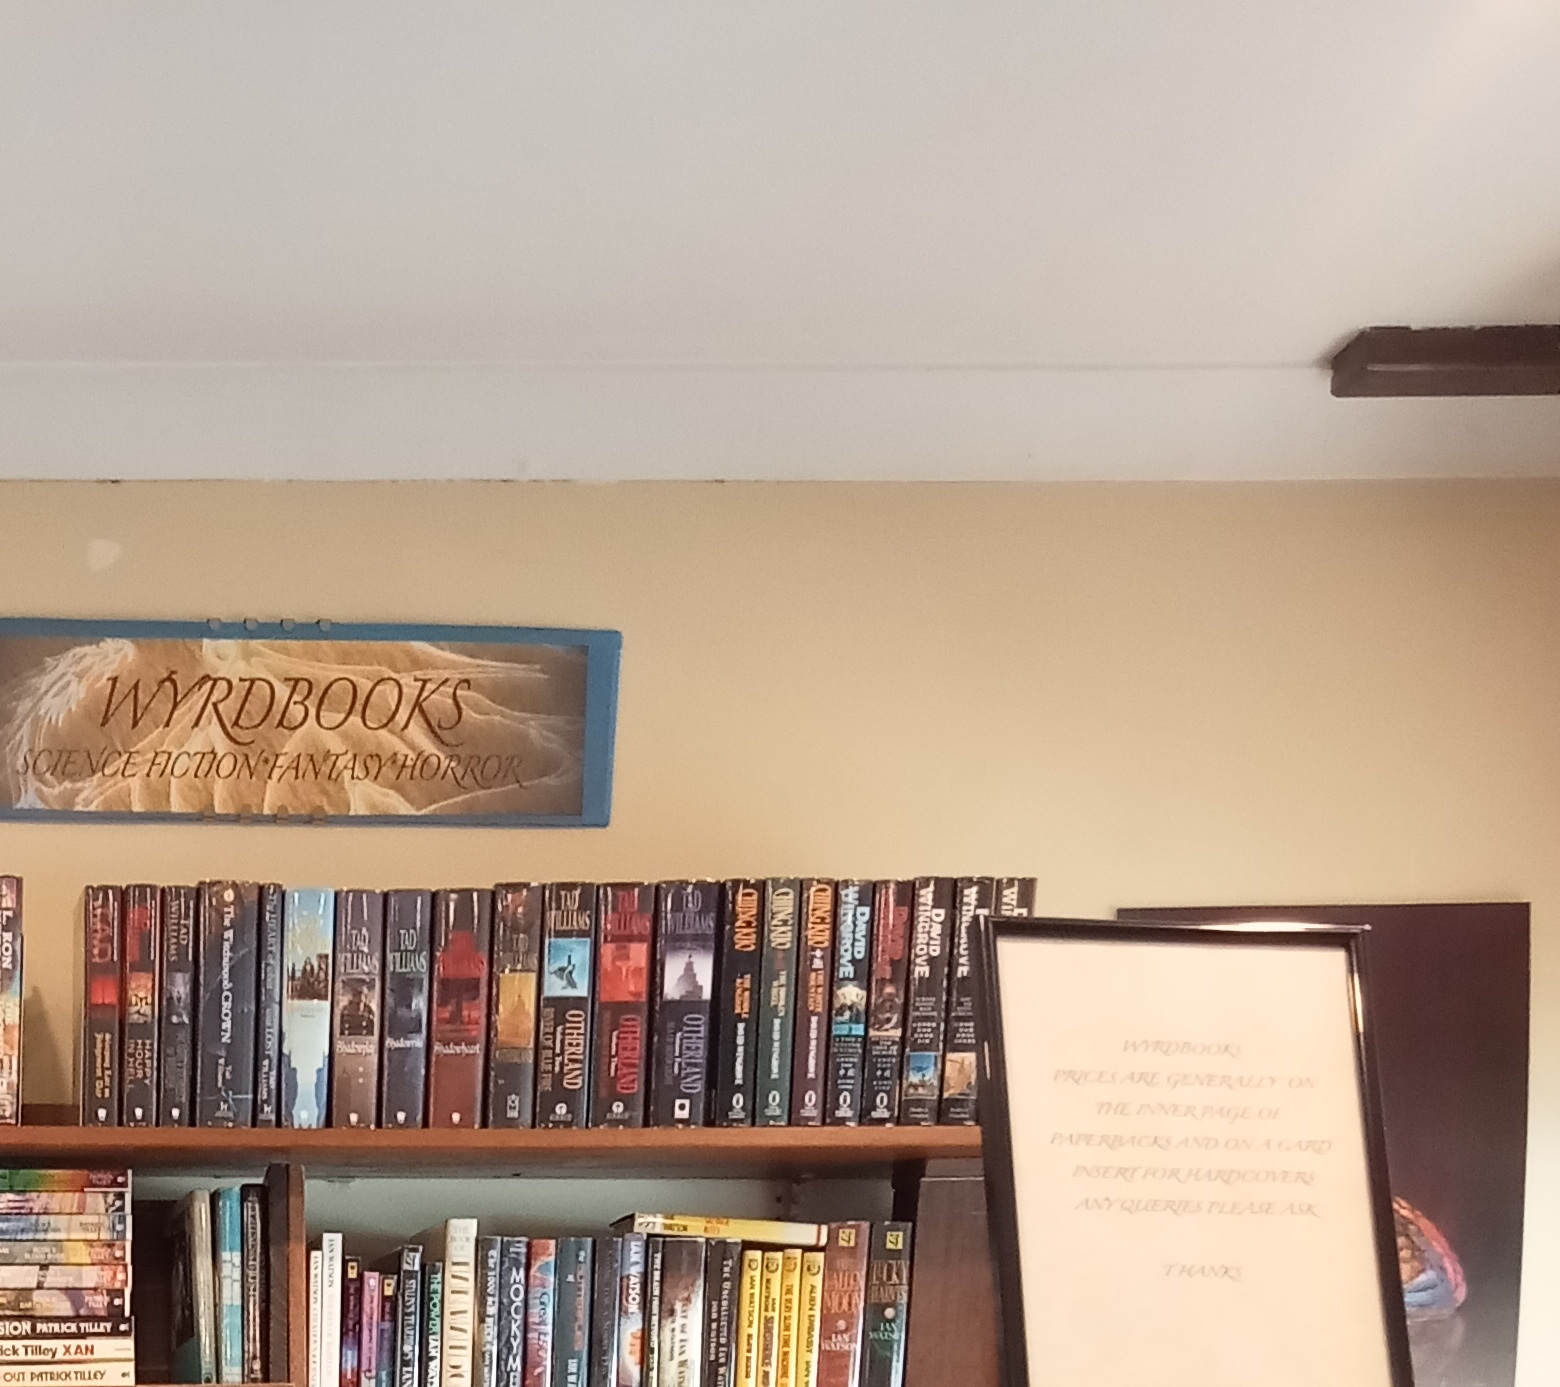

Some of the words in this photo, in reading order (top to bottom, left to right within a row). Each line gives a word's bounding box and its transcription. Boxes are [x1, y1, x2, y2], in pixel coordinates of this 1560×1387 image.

[100, 671, 473, 747] WYRDBOOKS
[17, 747, 138, 780] SCIENCE
[915, 887, 933, 978] WINGROVE
[929, 909, 946, 956] DAVID
[220, 991, 233, 1042] CROWN
[563, 1010, 585, 1089] OTHERLAND
[1123, 1039, 1242, 1058] WYRDBOOKS
[1053, 1069, 1117, 1086] PRICES
[1121, 1071, 1161, 1088] ARE
[1166, 1073, 1277, 1090] GENERALLY
[1288, 1077, 1319, 1089] ON
[1096, 1102, 1131, 1115] THE
[1136, 1102, 1202, 1120] INNER
[1202, 1105, 1252, 1124] PAGE
[1258, 1107, 1280, 1120] OF
[1050, 1132, 1172, 1151] PAPERBACKS
[1175, 1137, 1218, 1150] AND
[1224, 1138, 1252, 1150] ON
[1257, 1139, 1271, 1150] A
[1278, 1139, 1332, 1155] CARD
[1072, 1165, 1143, 1182] INSERT
[1142, 1168, 1188, 1184] FOR
[1186, 1168, 1315, 1186] HARDCOVERS
[1075, 1197, 1118, 1210] ANY
[1120, 1198, 1202, 1216] QUERIES
[1207, 1200, 1275, 1215] PLEASE
[1280, 1202, 1322, 1219] ASK
[1162, 1263, 1242, 1282] THANKS
[36, 1322, 78, 1333] PATRICK
[80, 1322, 112, 1333] TILLEY
[22, 1345, 58, 1358] Tilley
[63, 1344, 94, 1356] XAN
[30, 1371, 71, 1382] PATRICK
[73, 1370, 106, 1381] TILLEY
